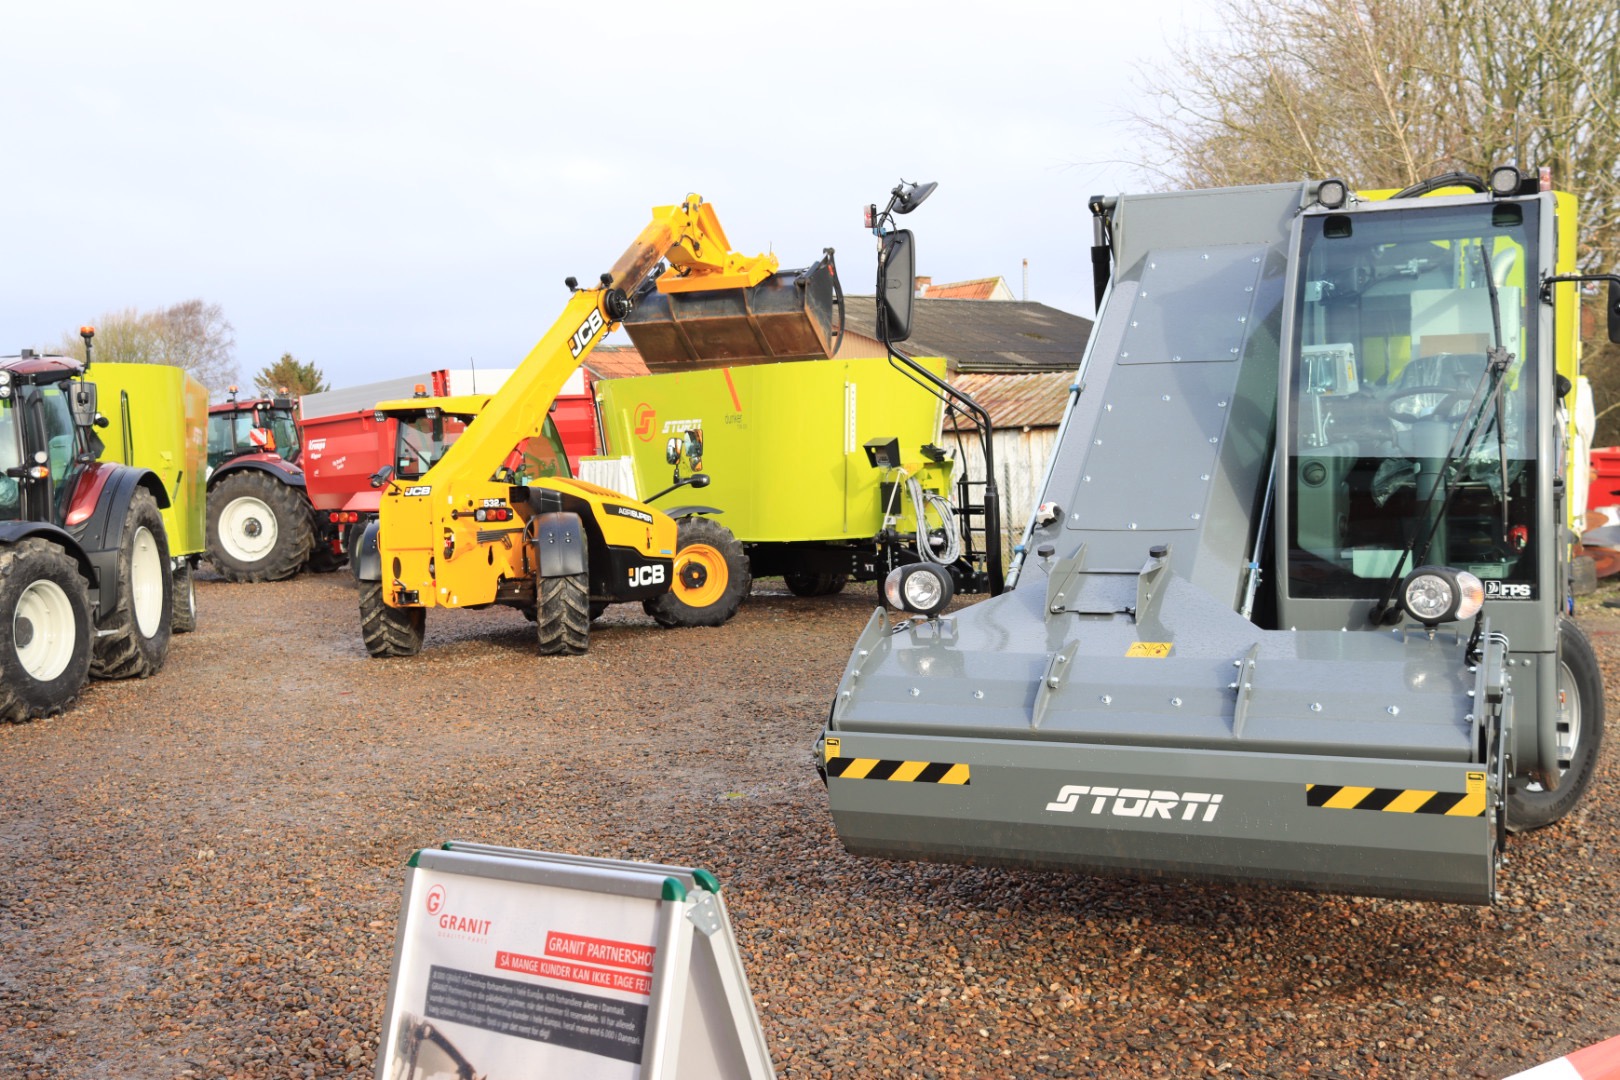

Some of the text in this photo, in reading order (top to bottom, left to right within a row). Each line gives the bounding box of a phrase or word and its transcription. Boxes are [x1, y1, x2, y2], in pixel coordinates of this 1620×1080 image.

[569, 308, 604, 358] JCB
[404, 486, 431, 496] JCB
[628, 564, 665, 587] JCB
[1501, 585, 1530, 596] FPS
[1045, 785, 1224, 822] STORTI
[439, 914, 491, 935] GRANIT
[548, 937, 585, 956] GRANIT
[500, 953, 510, 966] SÅ
[511, 958, 539, 972] MANGE
[540, 964, 570, 978] KUNDER
[572, 969, 589, 981] KAN
[592, 972, 610, 985] IKKE
[613, 976, 633, 989] TAGE
